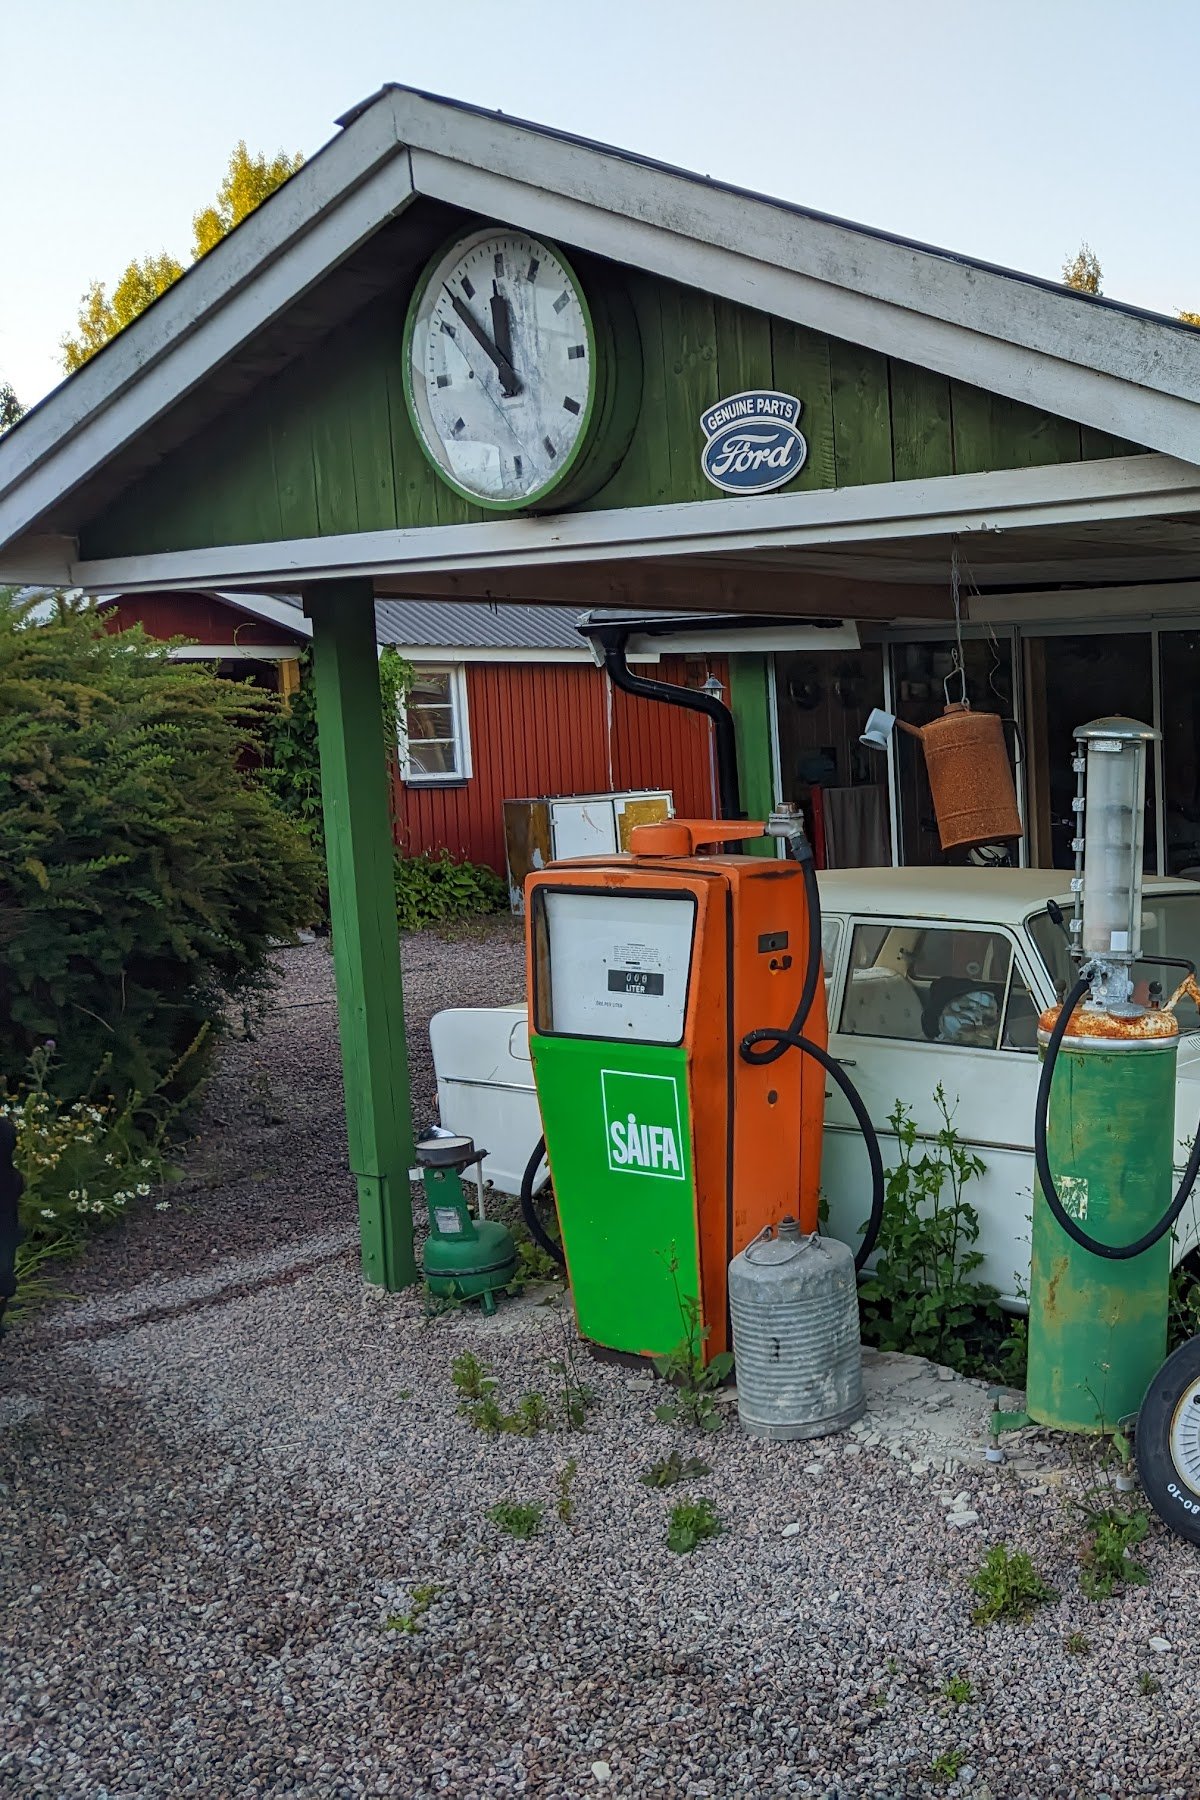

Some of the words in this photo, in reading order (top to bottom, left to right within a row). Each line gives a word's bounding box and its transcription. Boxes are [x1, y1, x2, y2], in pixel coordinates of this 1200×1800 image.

[707, 398, 754, 431] GENUINE
[757, 398, 793, 418] PARTS
[711, 433, 795, 476] Ford
[625, 984, 645, 994] LITER
[610, 1112, 680, 1171] SÅIFA
